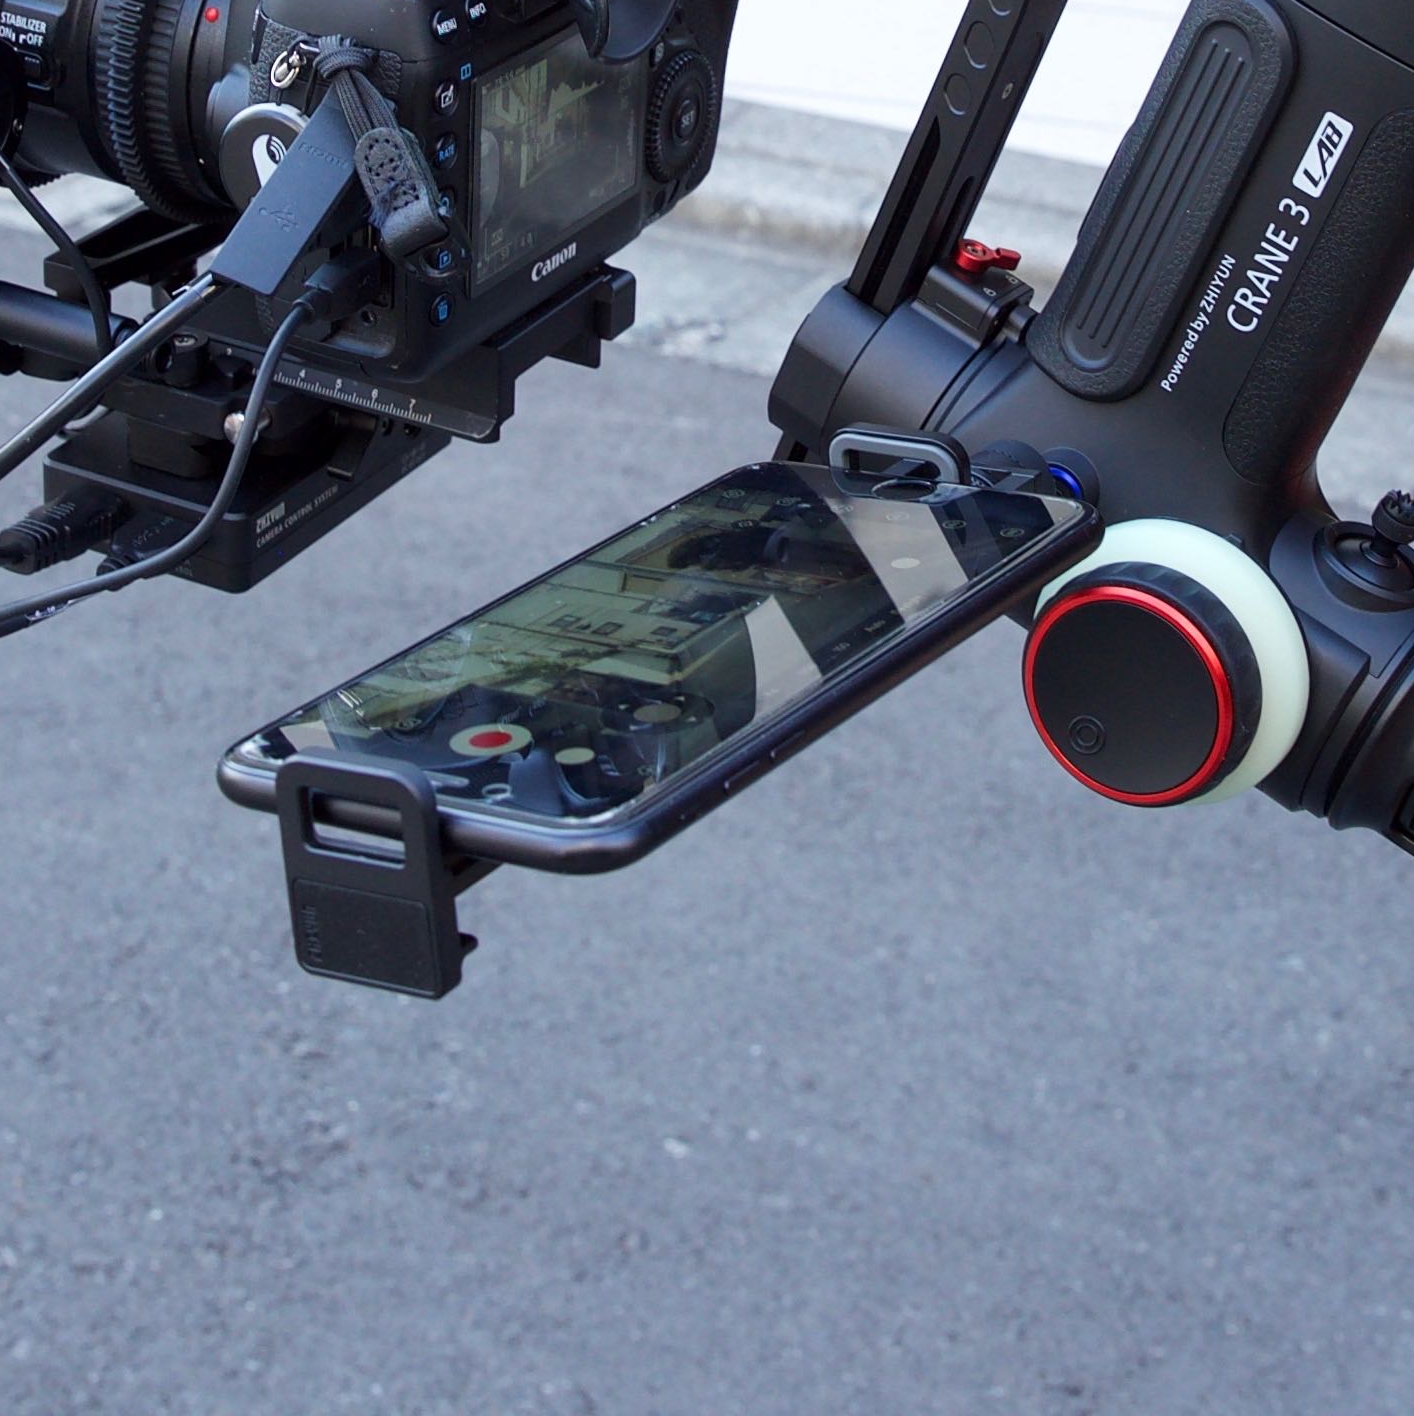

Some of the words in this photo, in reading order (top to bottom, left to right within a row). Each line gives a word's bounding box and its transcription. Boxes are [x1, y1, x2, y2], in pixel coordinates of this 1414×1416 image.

[0, 11, 47, 34] STABILIZER
[437, 17, 458, 36] MENU
[26, 34, 44, 48] OFF
[438, 143, 455, 162] RATE
[531, 242, 578, 282] Canon
[1226, 222, 1299, 333] CRANE
[1278, 197, 1311, 226] 3
[1199, 254, 1237, 314] ZHIYUN
[1189, 311, 1211, 332] by
[1160, 329, 1200, 392] Powered
[256, 524, 284, 549] CAMERA
[283, 503, 314, 529] CONTROL
